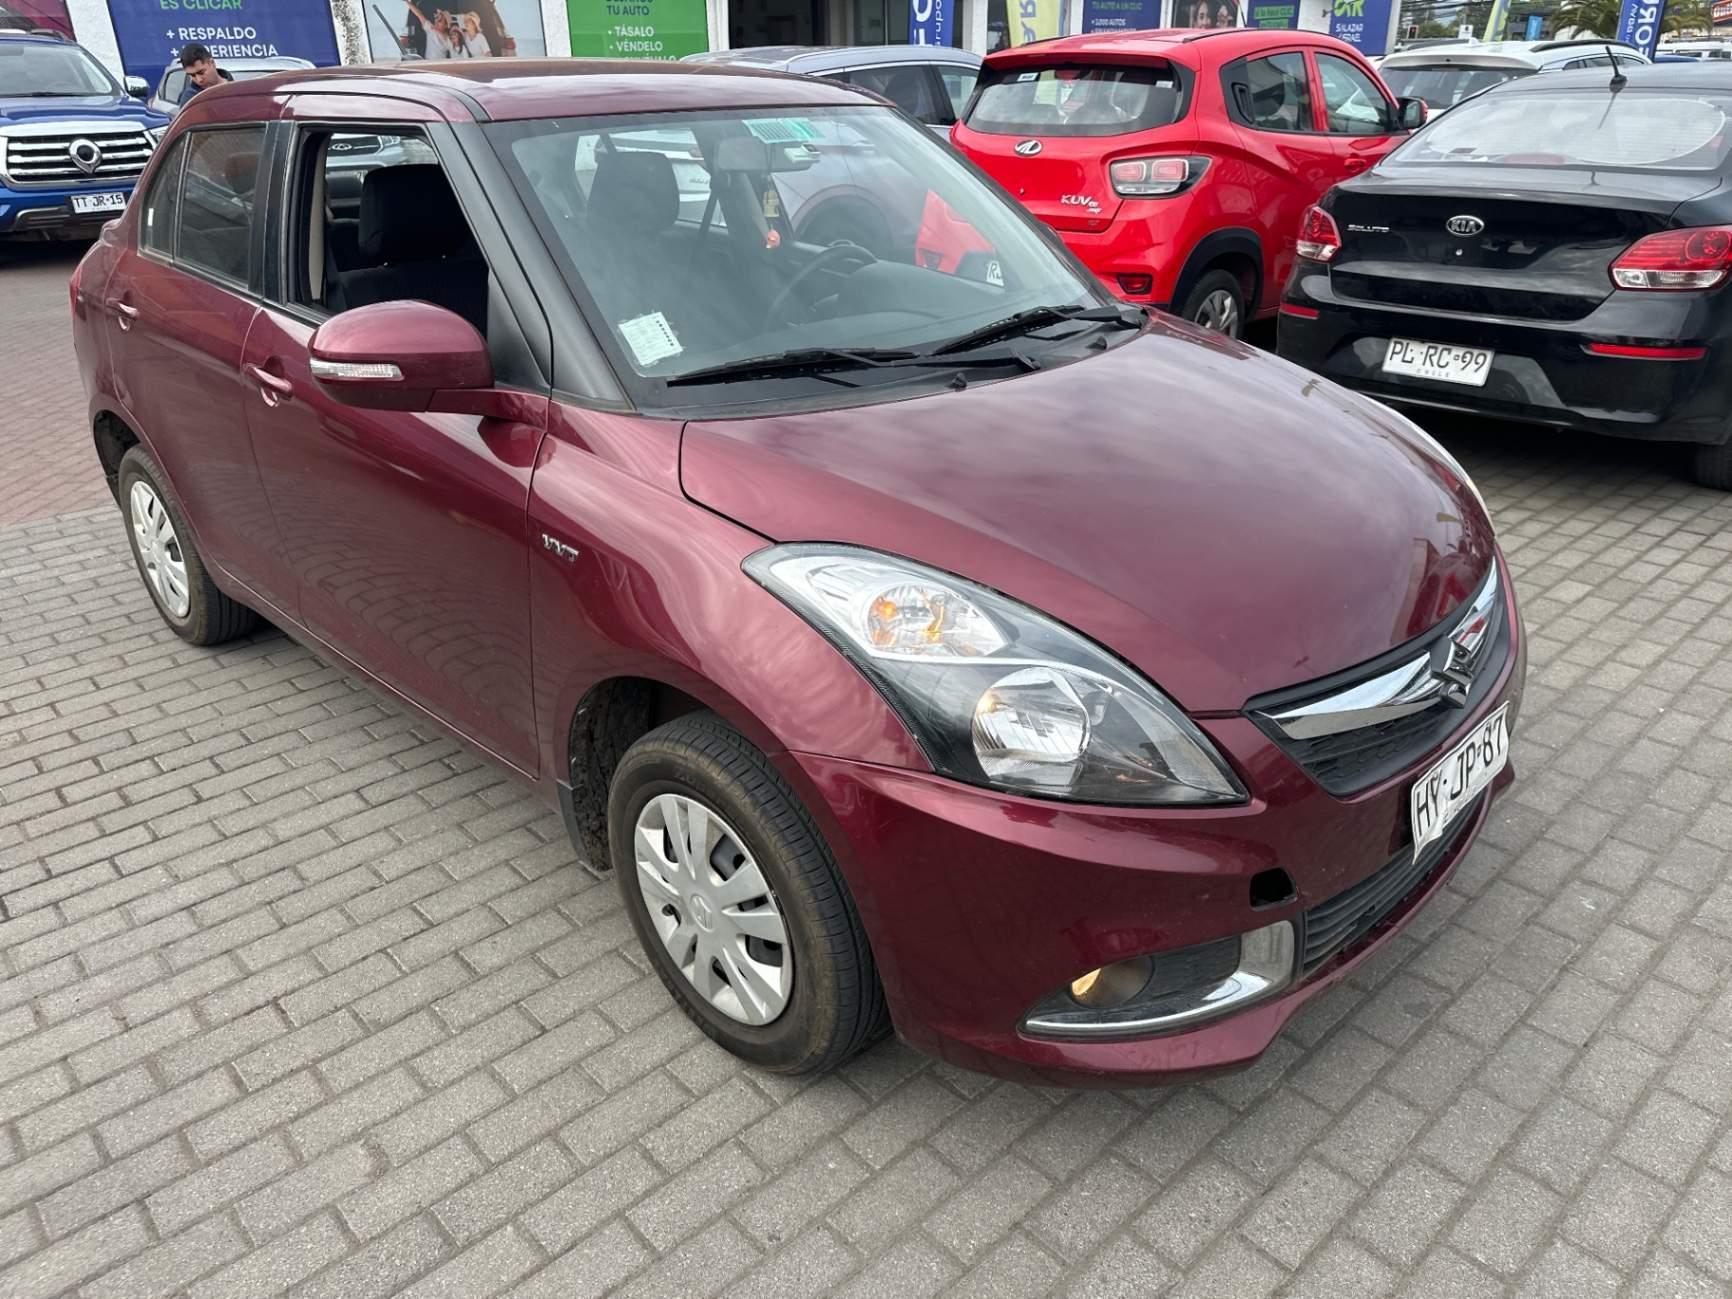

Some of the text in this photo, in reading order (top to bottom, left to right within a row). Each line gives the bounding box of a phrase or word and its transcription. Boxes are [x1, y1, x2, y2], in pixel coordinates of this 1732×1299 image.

[160, 0, 243, 9] ES CLICAR
[607, 5, 650, 15] TU AUTO
[178, 27, 257, 40] RESPALDO
[614, 24, 655, 37] TÁSALO
[616, 39, 663, 52] VÉNDELO
[1450, 219, 1477, 233] KIA
